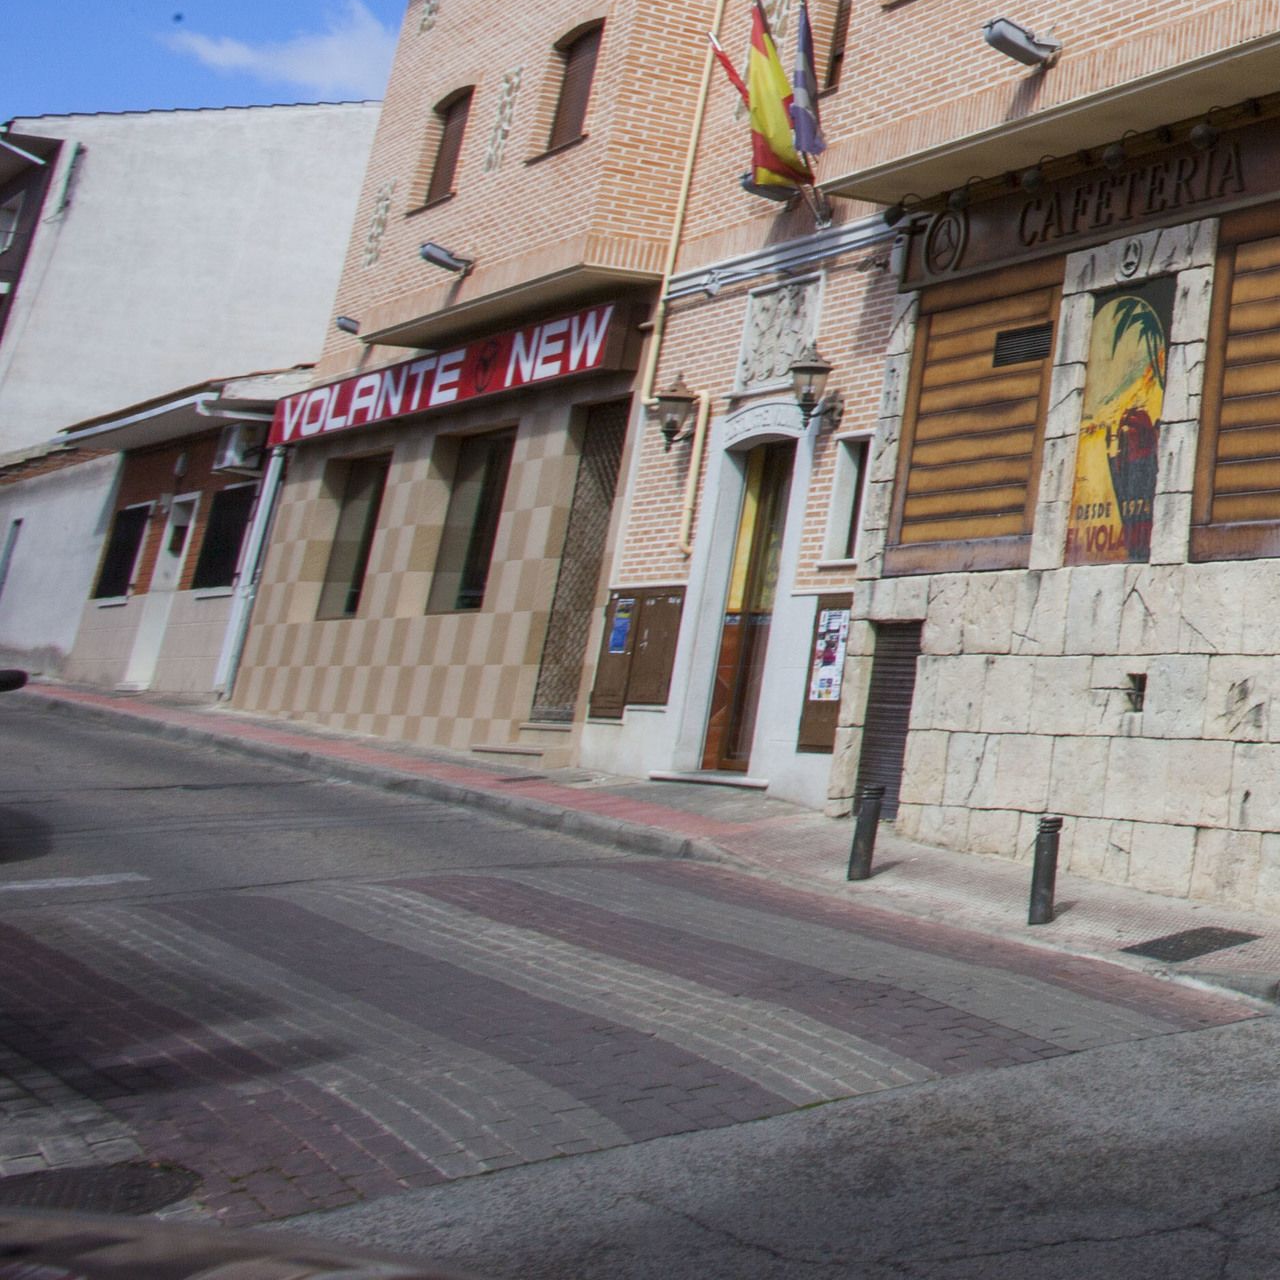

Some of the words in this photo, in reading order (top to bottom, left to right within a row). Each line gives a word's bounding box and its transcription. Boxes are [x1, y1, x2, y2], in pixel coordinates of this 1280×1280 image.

[283, 348, 467, 441] VOLANTE
[504, 305, 615, 388] NEW
[1076, 501, 1112, 521] DESDE
